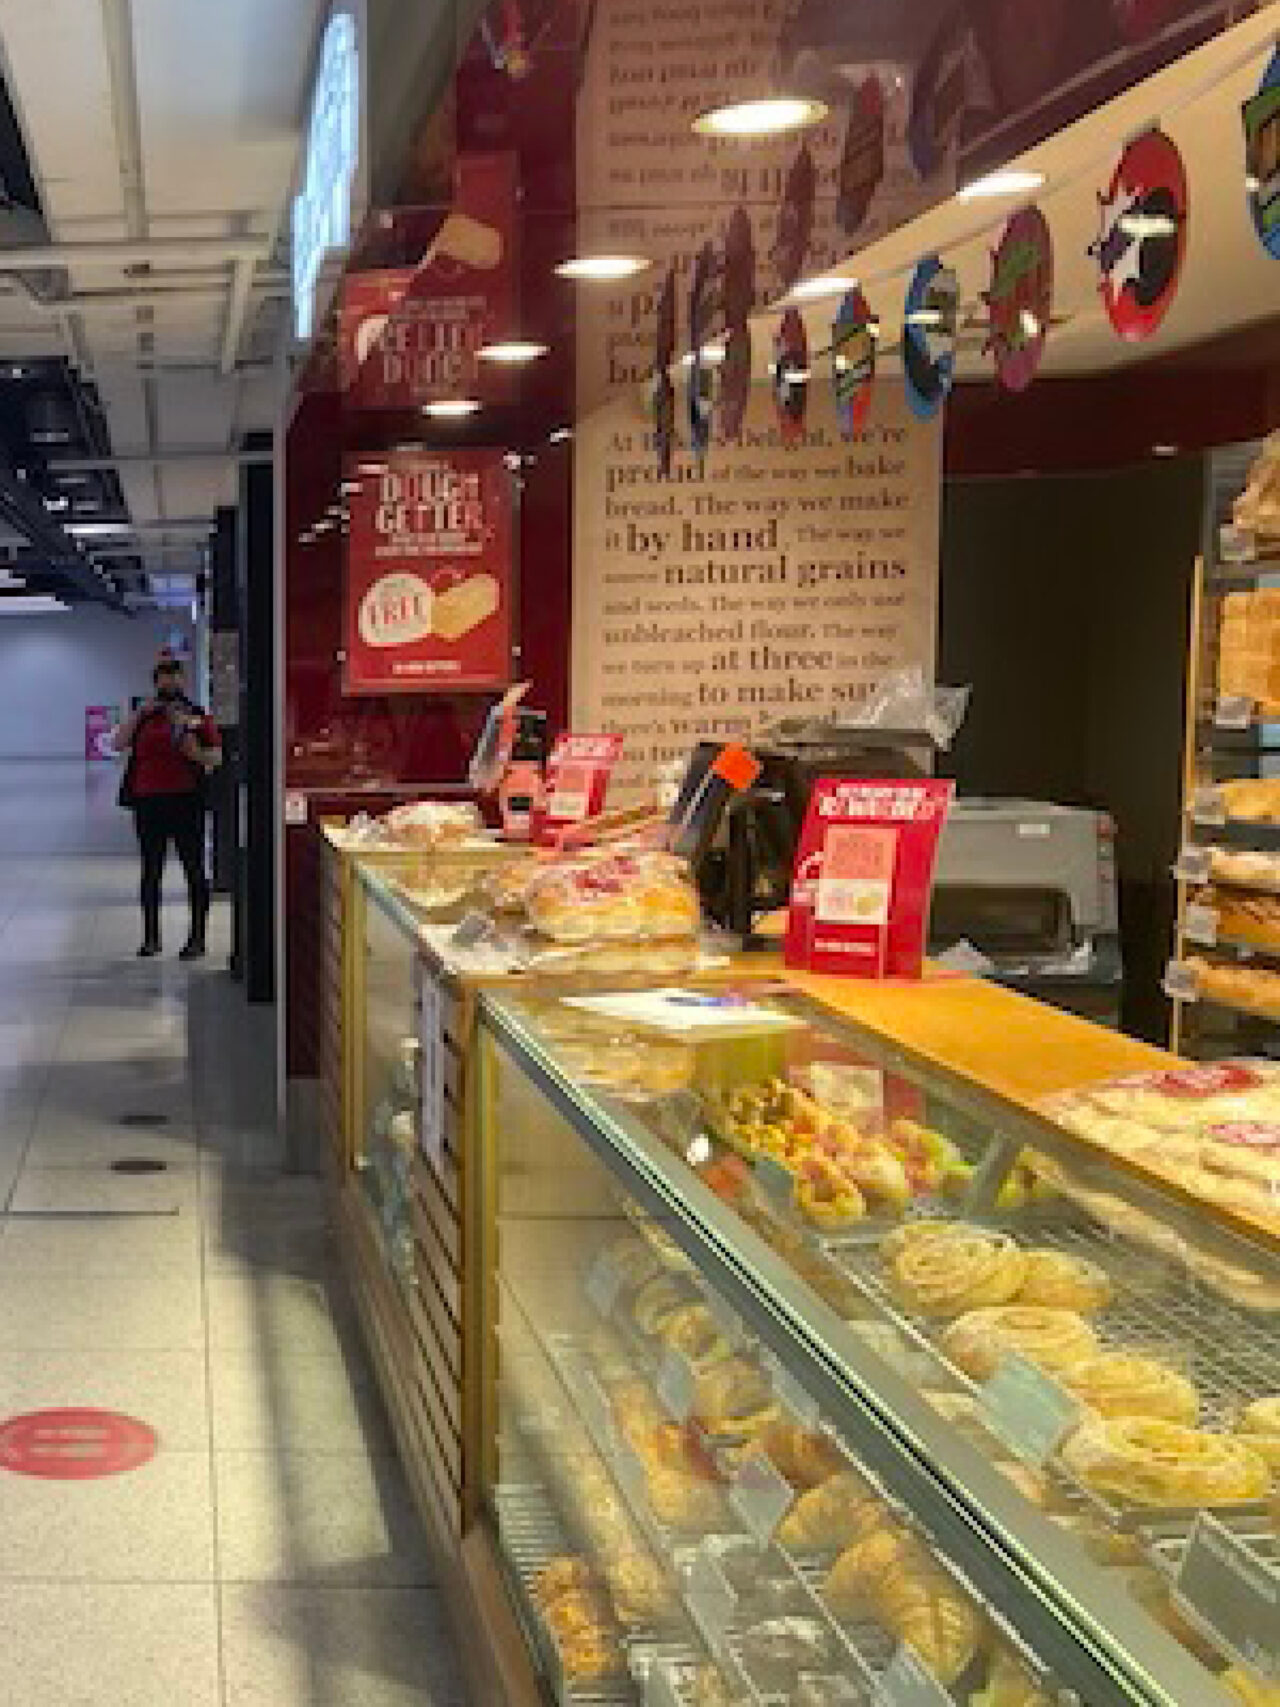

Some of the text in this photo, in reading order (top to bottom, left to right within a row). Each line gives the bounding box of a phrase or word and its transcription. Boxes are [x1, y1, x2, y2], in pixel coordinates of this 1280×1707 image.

[846, 455, 906, 478] bake
[381, 472, 480, 503] DOUGH
[376, 501, 483, 533] GETTER
[604, 489, 908, 520] bread. The way we make
[626, 523, 671, 560] by
[664, 554, 787, 585] natural
[796, 551, 907, 588] grains
[710, 593, 742, 612] The
[603, 619, 744, 645] unbleached
[750, 619, 816, 642] flour.
[710, 648, 740, 672] at
[749, 645, 833, 671] three
[698, 682, 729, 705] to
[737, 678, 825, 704] make
